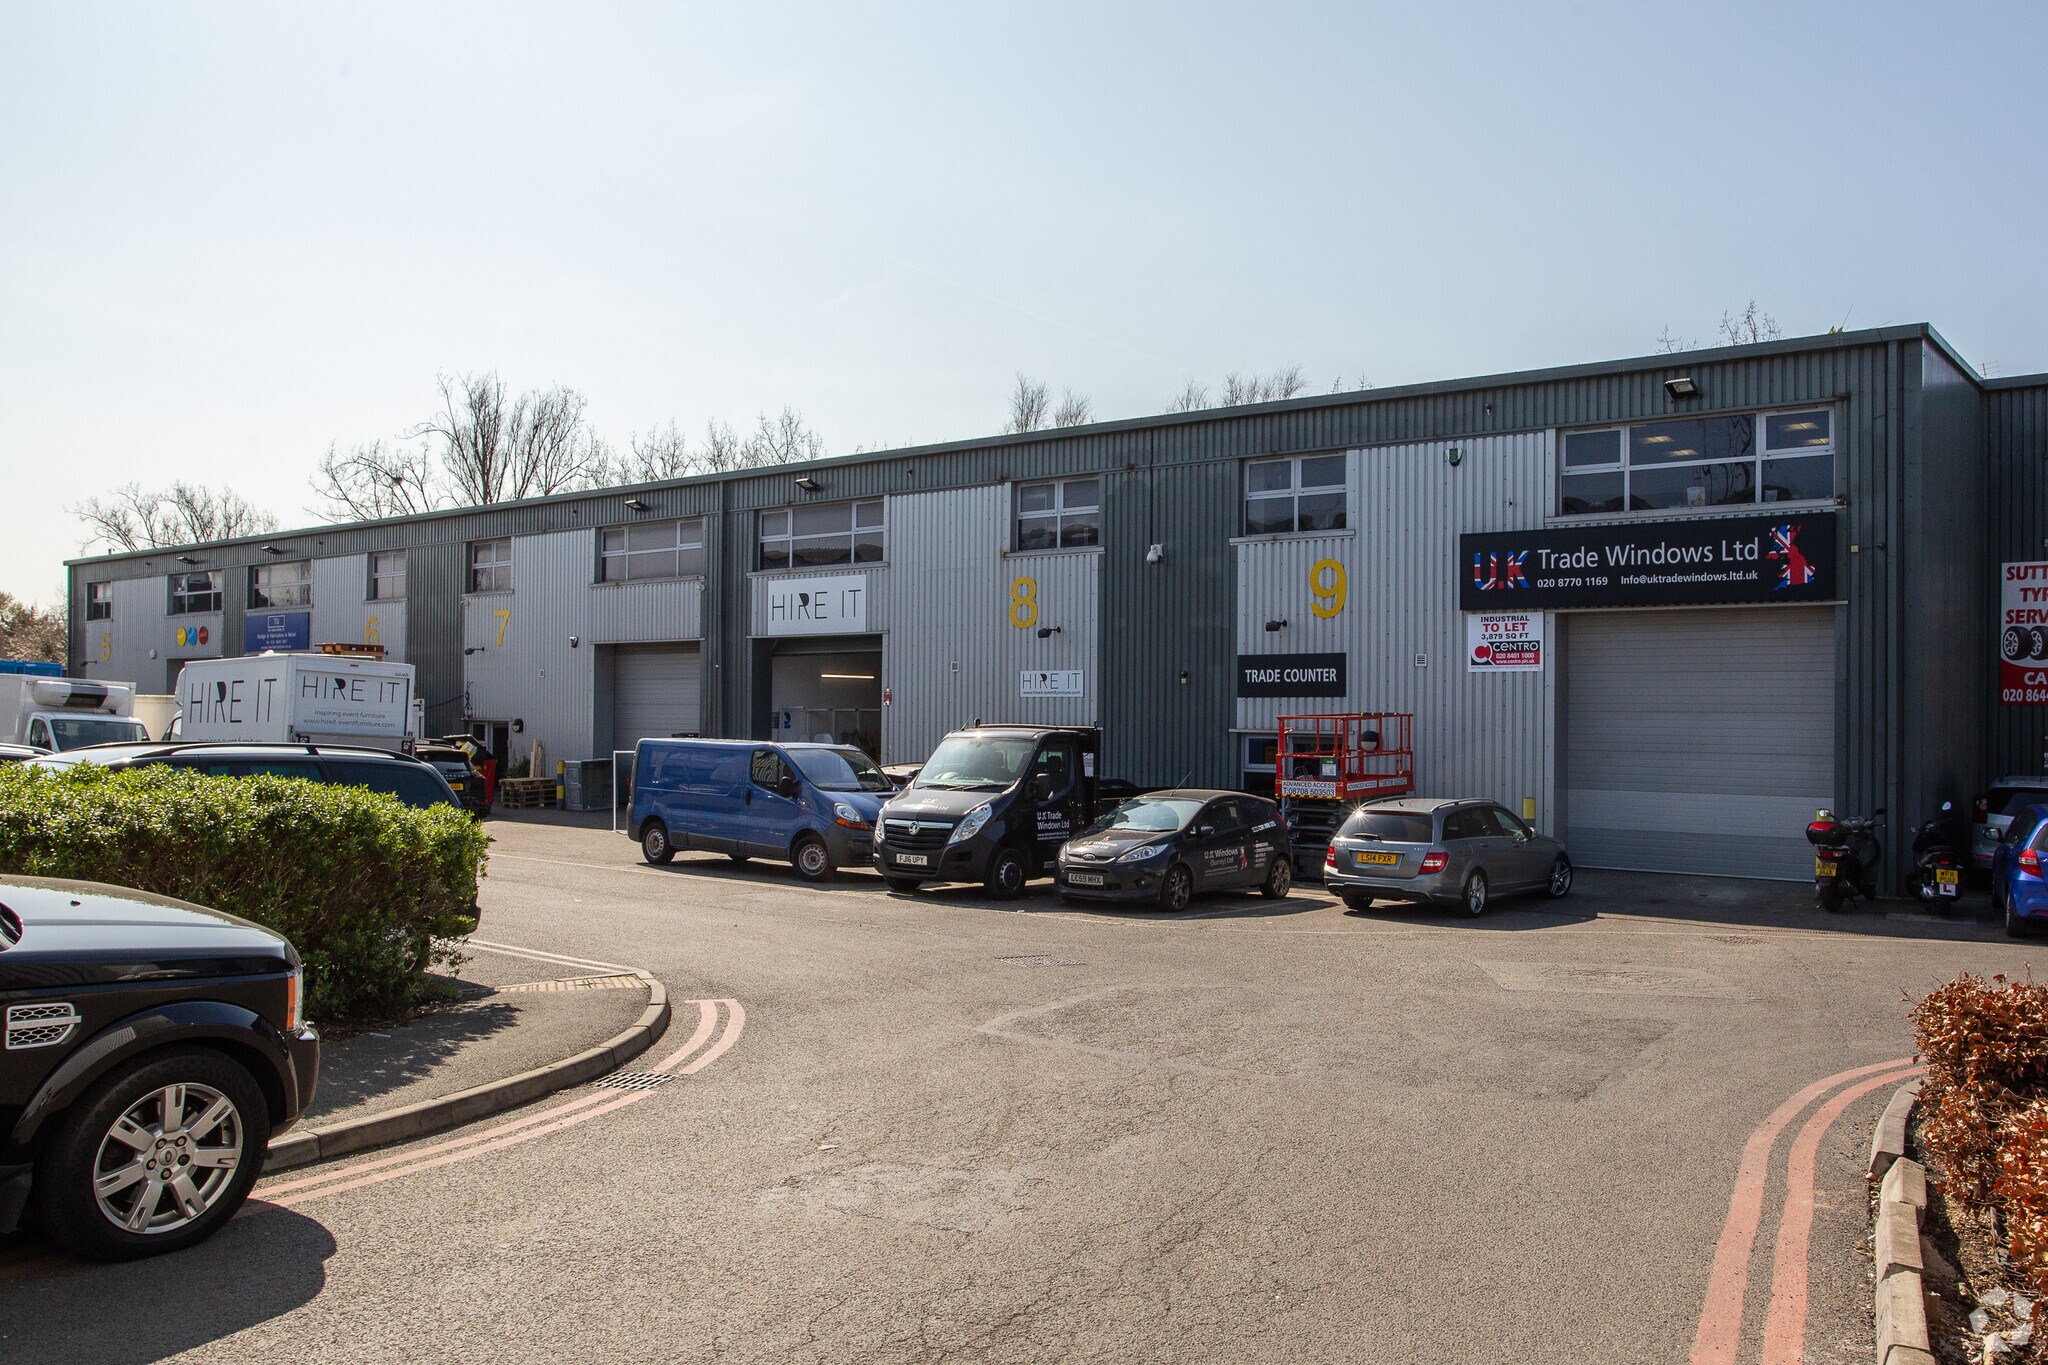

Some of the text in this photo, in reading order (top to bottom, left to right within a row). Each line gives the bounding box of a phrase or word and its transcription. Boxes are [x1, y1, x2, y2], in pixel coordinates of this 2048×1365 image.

[1474, 537, 1759, 591] U.K Trade Windows Ltd
[1309, 558, 1347, 619] 9
[1537, 578, 1555, 588] 020
[1558, 577, 1582, 587] 8770
[1586, 576, 1608, 586] 1169
[771, 589, 861, 621] HIRE IT
[1009, 575, 1038, 630] 8
[365, 615, 379, 645] 6
[494, 609, 511, 647] 7
[1483, 622, 1528, 632] TO LET
[101, 632, 112, 661] 5
[1023, 672, 1080, 689] HIRE IT
[1245, 668, 1337, 683] TRADE COUNTER
[302, 675, 400, 704] HIRE IT
[2003, 688, 2048, 701] 020 864
[189, 678, 277, 723] HIRE IT
[314, 710, 341, 718] Inspiring
[1062, 819, 1070, 829] Ltd
[1214, 847, 1239, 858] Windows
[1361, 854, 1392, 863] LS14 FXR
[1943, 884, 1953, 894] L
